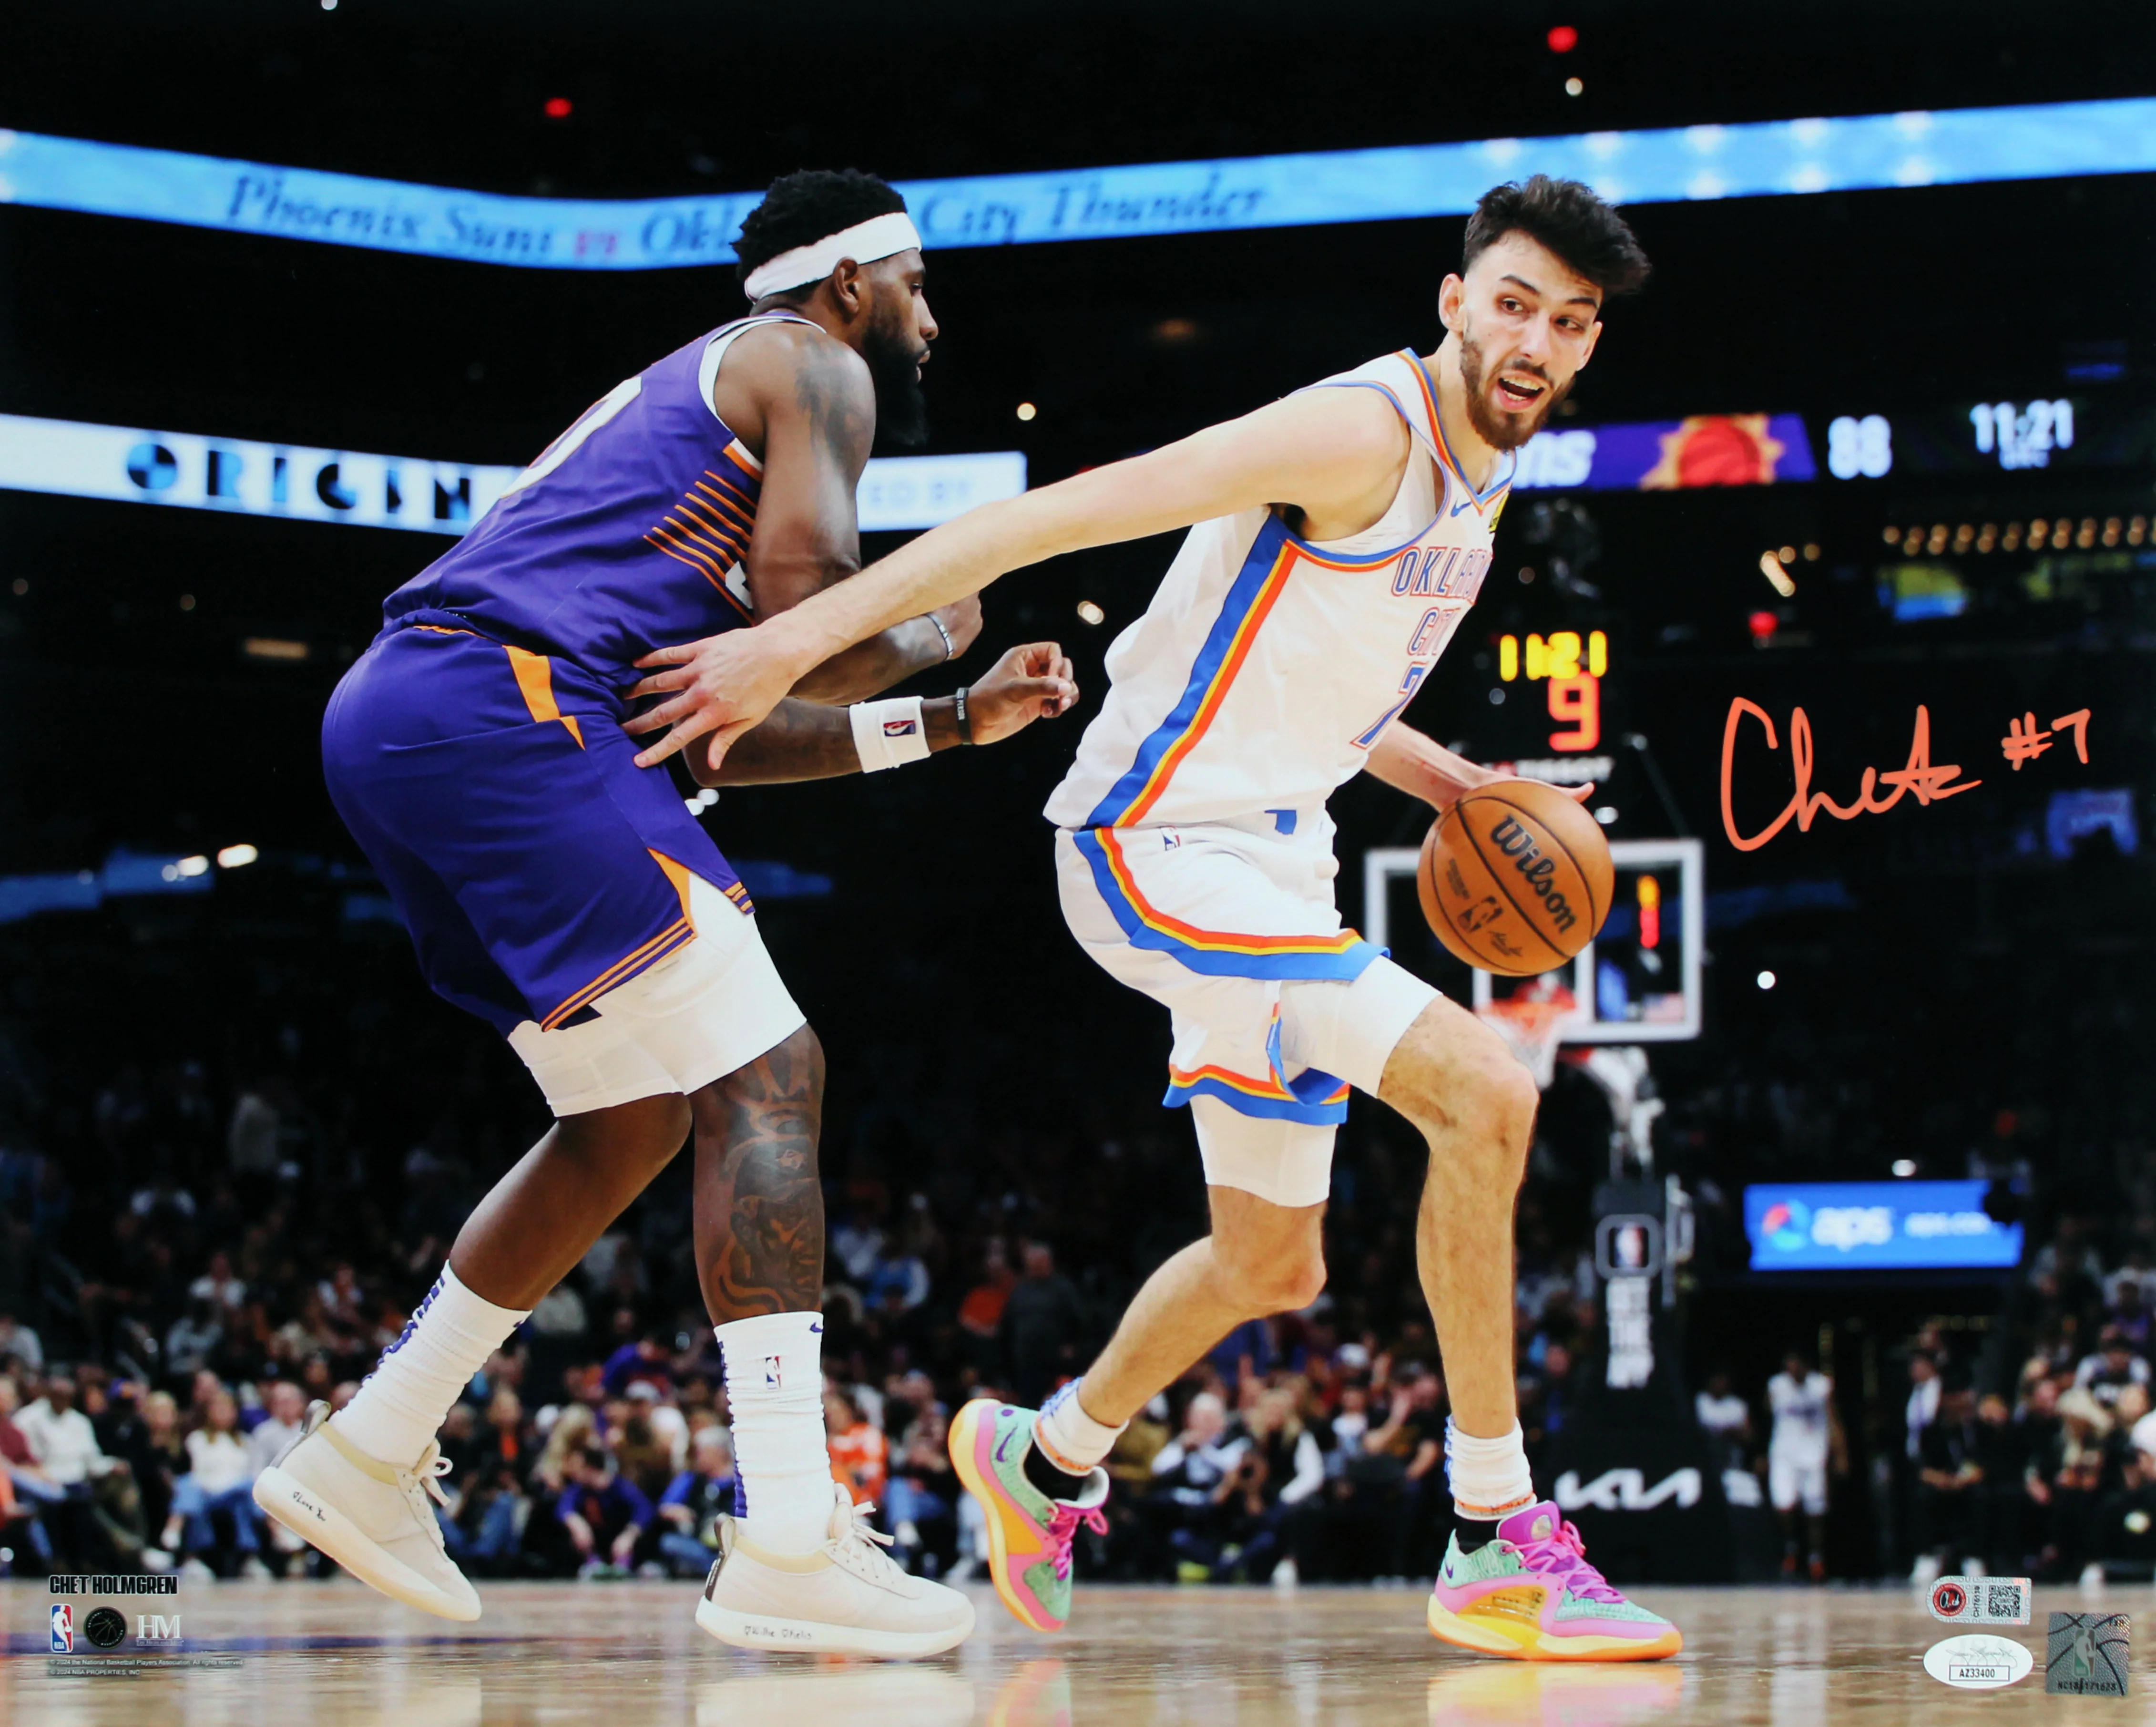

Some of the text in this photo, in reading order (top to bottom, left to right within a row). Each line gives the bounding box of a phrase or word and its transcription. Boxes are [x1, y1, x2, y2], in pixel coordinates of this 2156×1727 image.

[1548, 670, 1600, 751] 9
[2002, 709, 2091, 771] #7
[1490, 813, 1577, 935] Wilson
[1959, 1668, 1996, 1678] AZ33400
